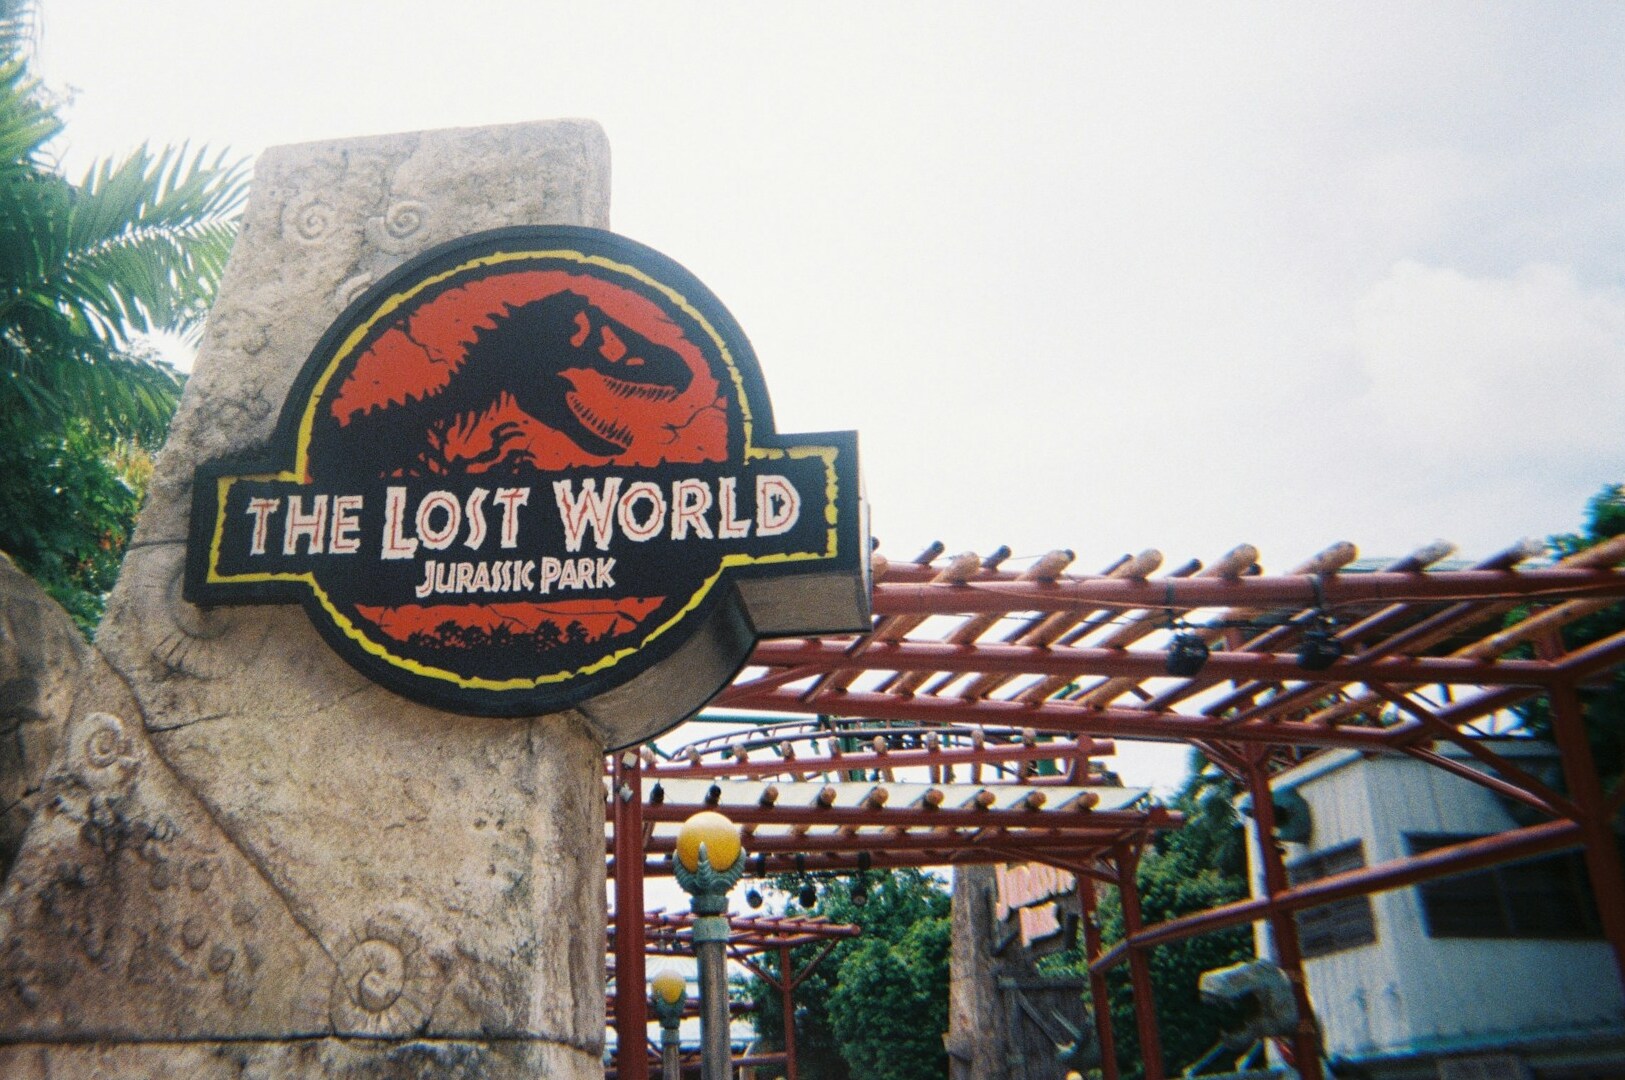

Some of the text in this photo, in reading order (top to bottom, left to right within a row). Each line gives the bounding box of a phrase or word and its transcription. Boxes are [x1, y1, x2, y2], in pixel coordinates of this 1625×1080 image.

[247, 475, 801, 560] THE LOST WORLD
[415, 556, 617, 598] JURASSIC PARK
